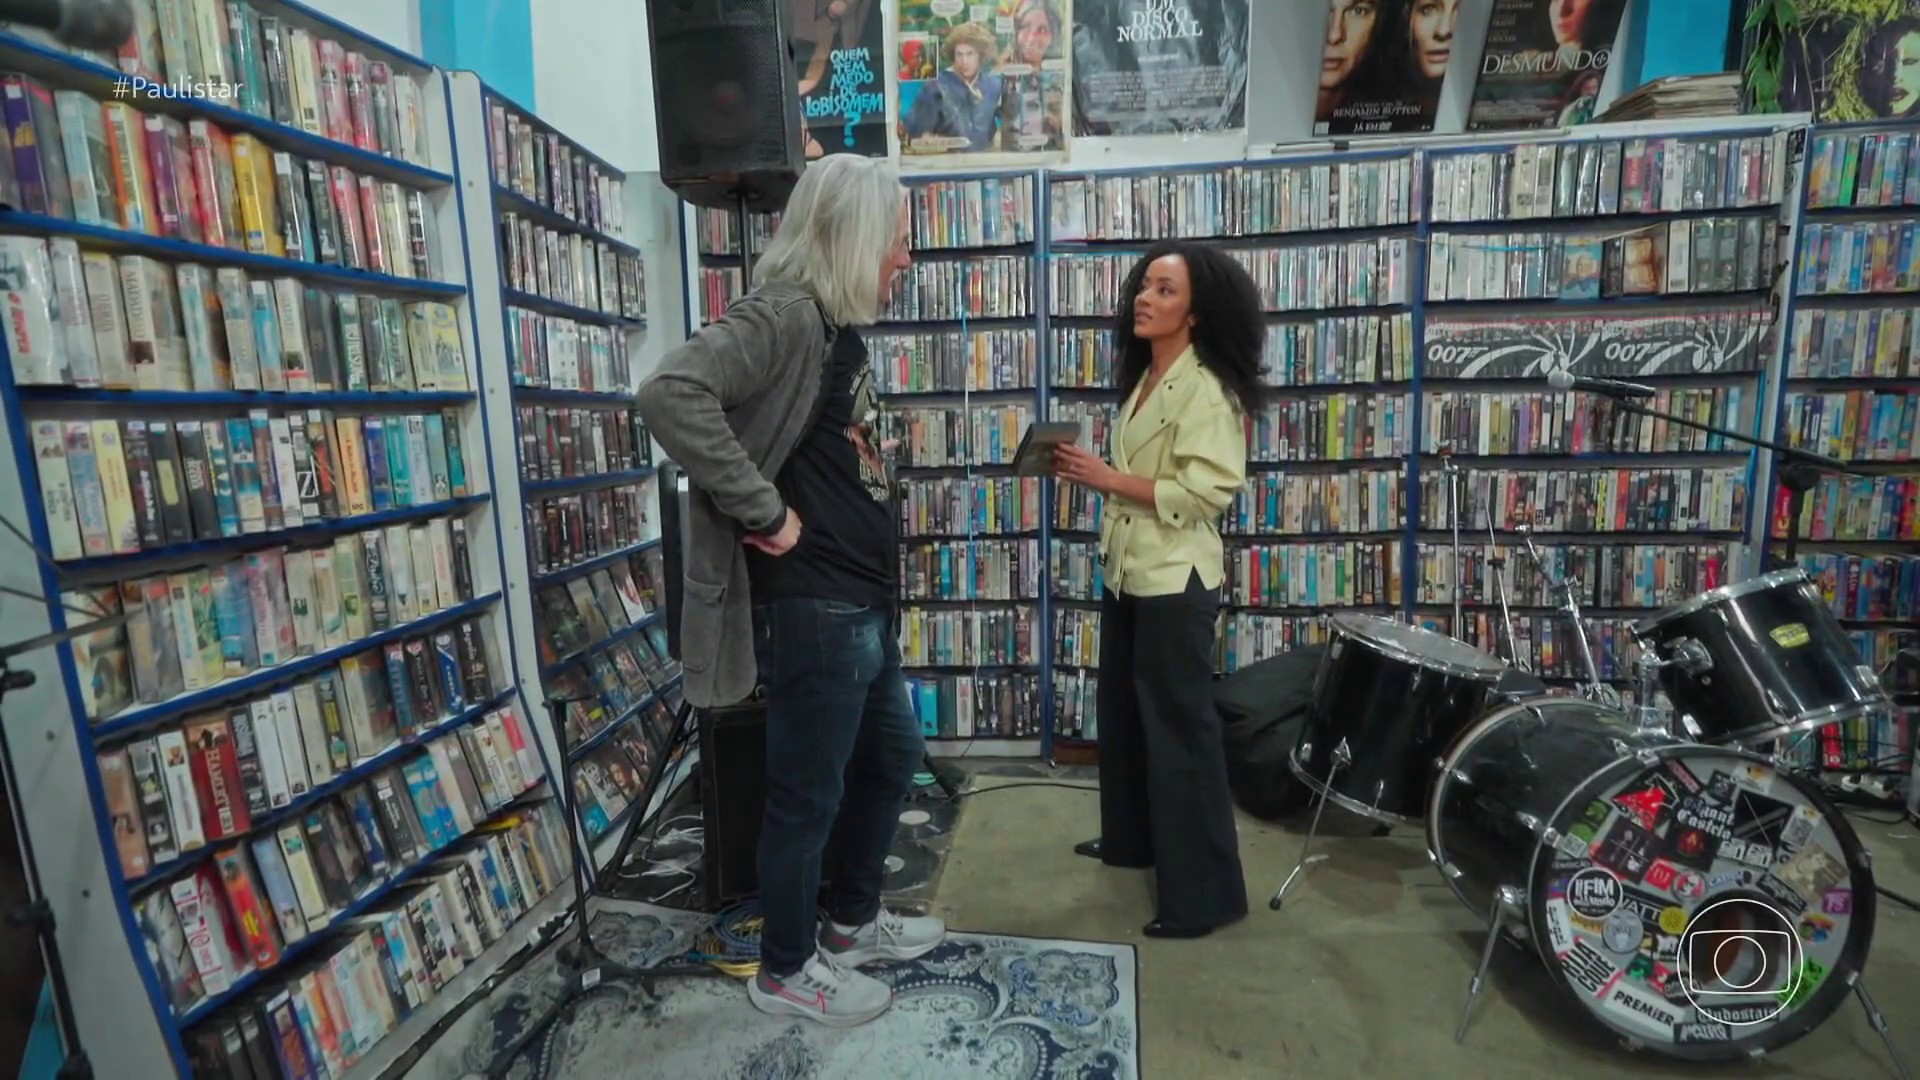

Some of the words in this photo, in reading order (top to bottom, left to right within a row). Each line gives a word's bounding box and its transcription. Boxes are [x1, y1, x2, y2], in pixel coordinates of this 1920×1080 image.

[1132, 8, 1188, 27] DISCO
[1117, 21, 1203, 43] NORMAL
[830, 47, 870, 63] QUEM
[1482, 48, 1612, 75] DESMUNDO
[833, 61, 866, 76] TEM
[831, 72, 874, 90] MEDO
[840, 85, 857, 98] DE
[1333, 106, 1381, 118] BENJAMIN
[1382, 105, 1422, 116] BUTTON
[843, 112, 862, 147] ?
[1428, 343, 1489, 364] 007
[1604, 341, 1668, 362] 007
